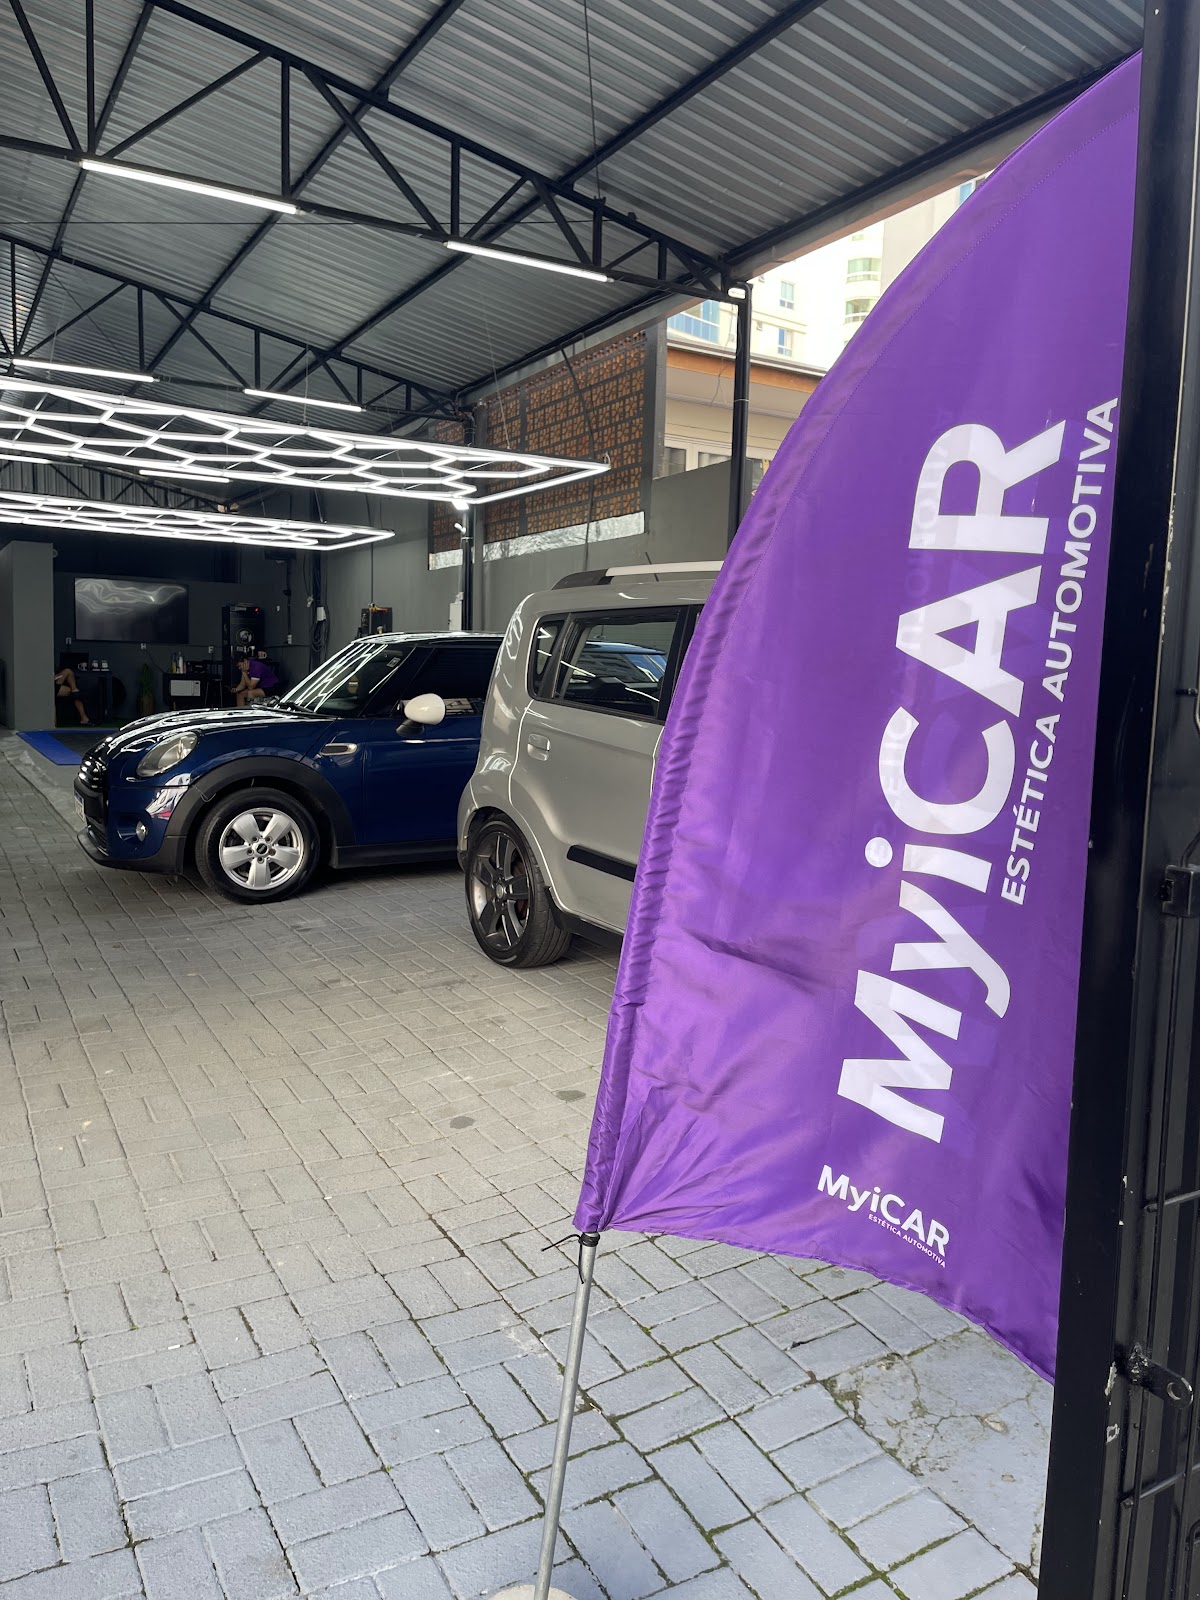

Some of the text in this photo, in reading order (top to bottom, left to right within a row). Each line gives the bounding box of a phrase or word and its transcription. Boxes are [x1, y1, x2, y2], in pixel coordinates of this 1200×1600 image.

[836, 420, 1067, 1143] MyiCAR
[1000, 397, 1119, 905] ESTÉTICA AUTOMOTIVA
[817, 1164, 950, 1257] MyiCAR
[868, 1213, 946, 1268] ESTÉTICA AUTOMOTIVA
